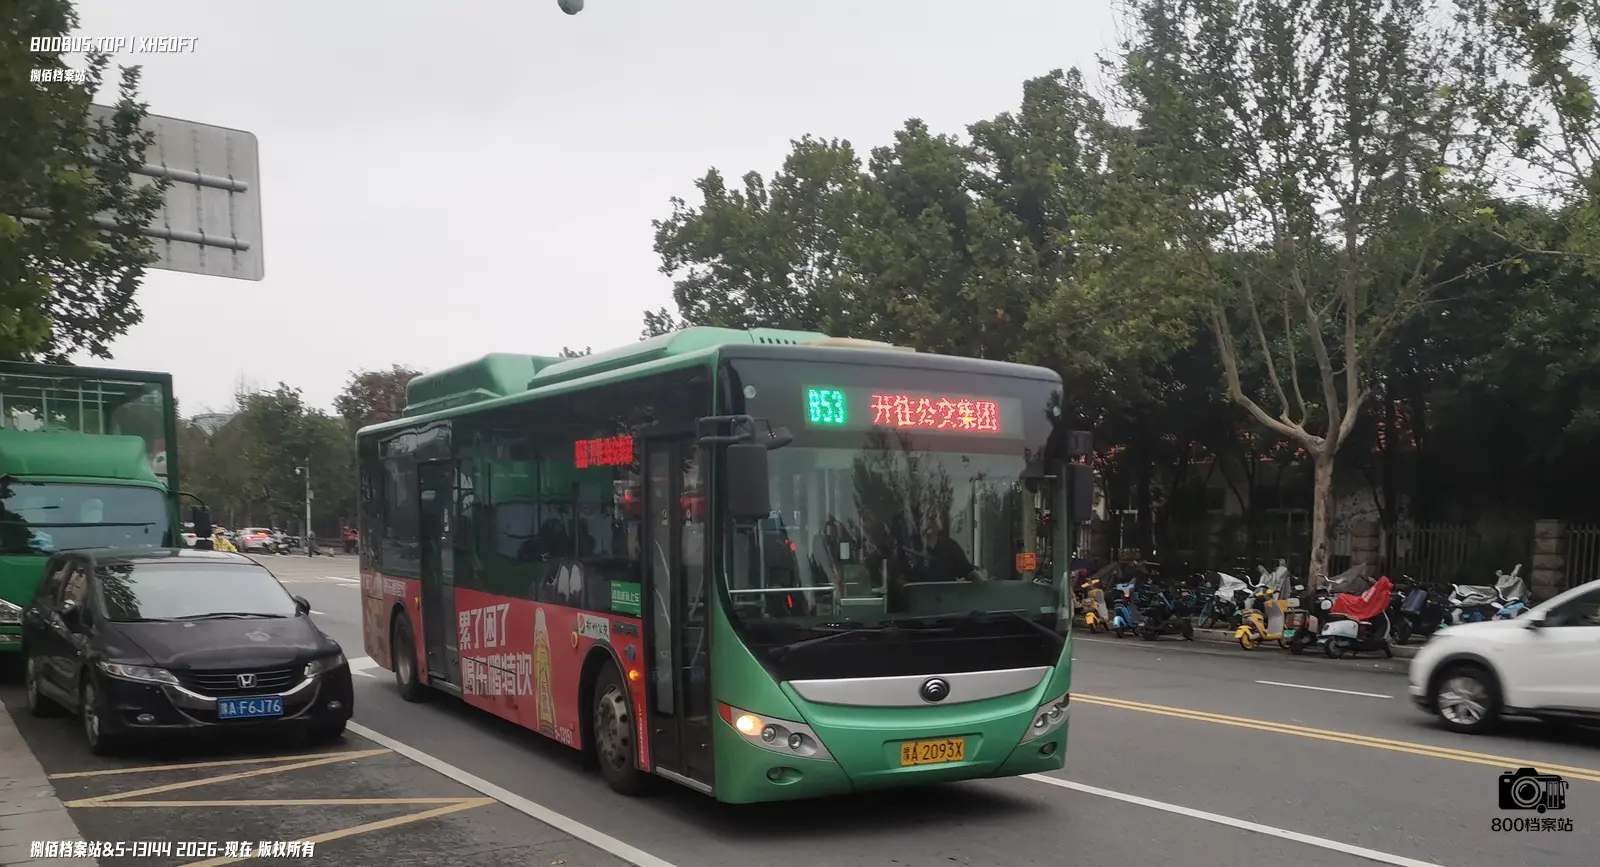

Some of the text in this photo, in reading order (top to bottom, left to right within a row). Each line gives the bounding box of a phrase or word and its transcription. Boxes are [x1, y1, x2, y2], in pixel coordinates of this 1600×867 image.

[870, 394, 998, 431] 开往公交集团
[459, 603, 510, 650] 累了困了
[462, 651, 533, 696] 喝东鹏特饮
